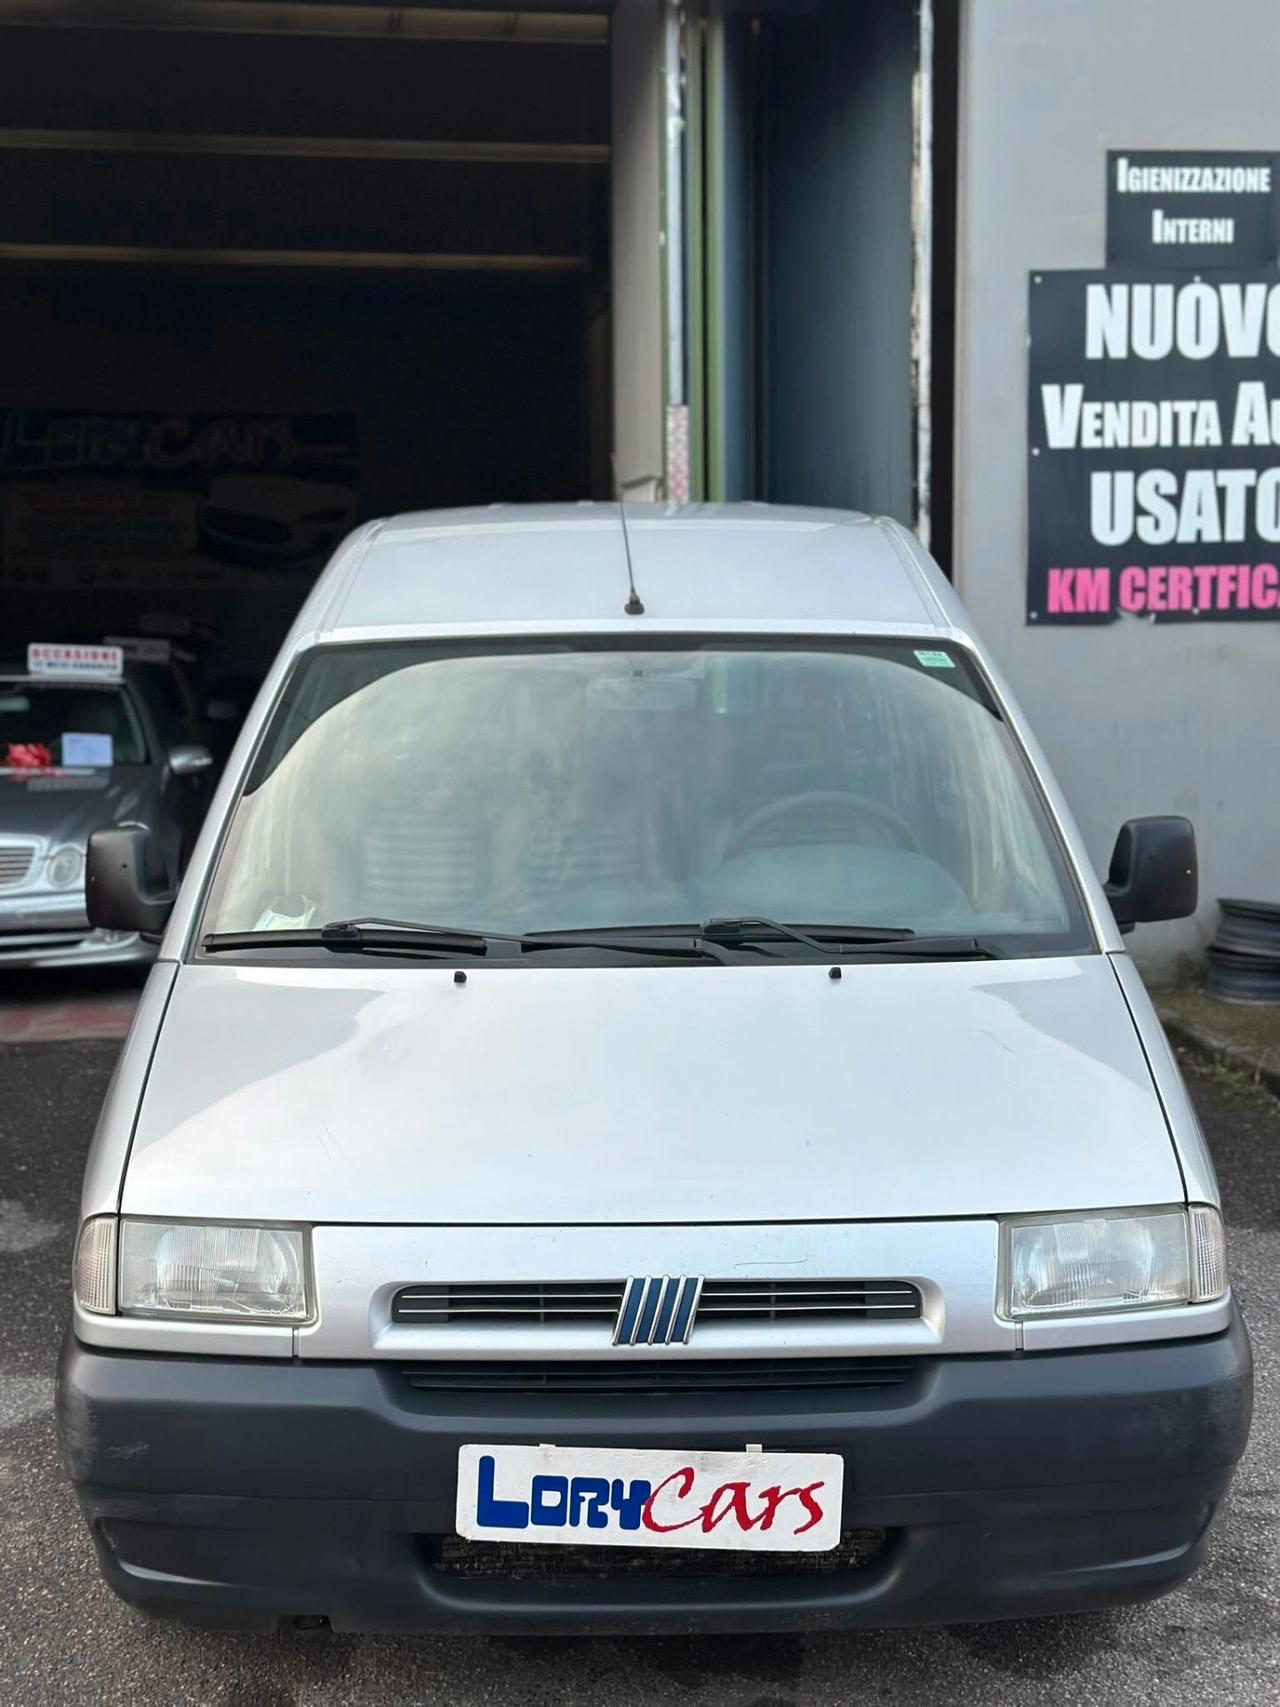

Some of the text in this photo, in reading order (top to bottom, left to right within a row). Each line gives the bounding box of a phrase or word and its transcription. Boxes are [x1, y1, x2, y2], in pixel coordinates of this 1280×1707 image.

[1116, 157, 1272, 193] IGIENIZZAZIONE
[1152, 208, 1235, 244] INTERNI
[1041, 383, 1223, 449] VENDITA
[1090, 467, 1280, 546] USATO
[1047, 562, 1280, 614] KM CERTFIC
